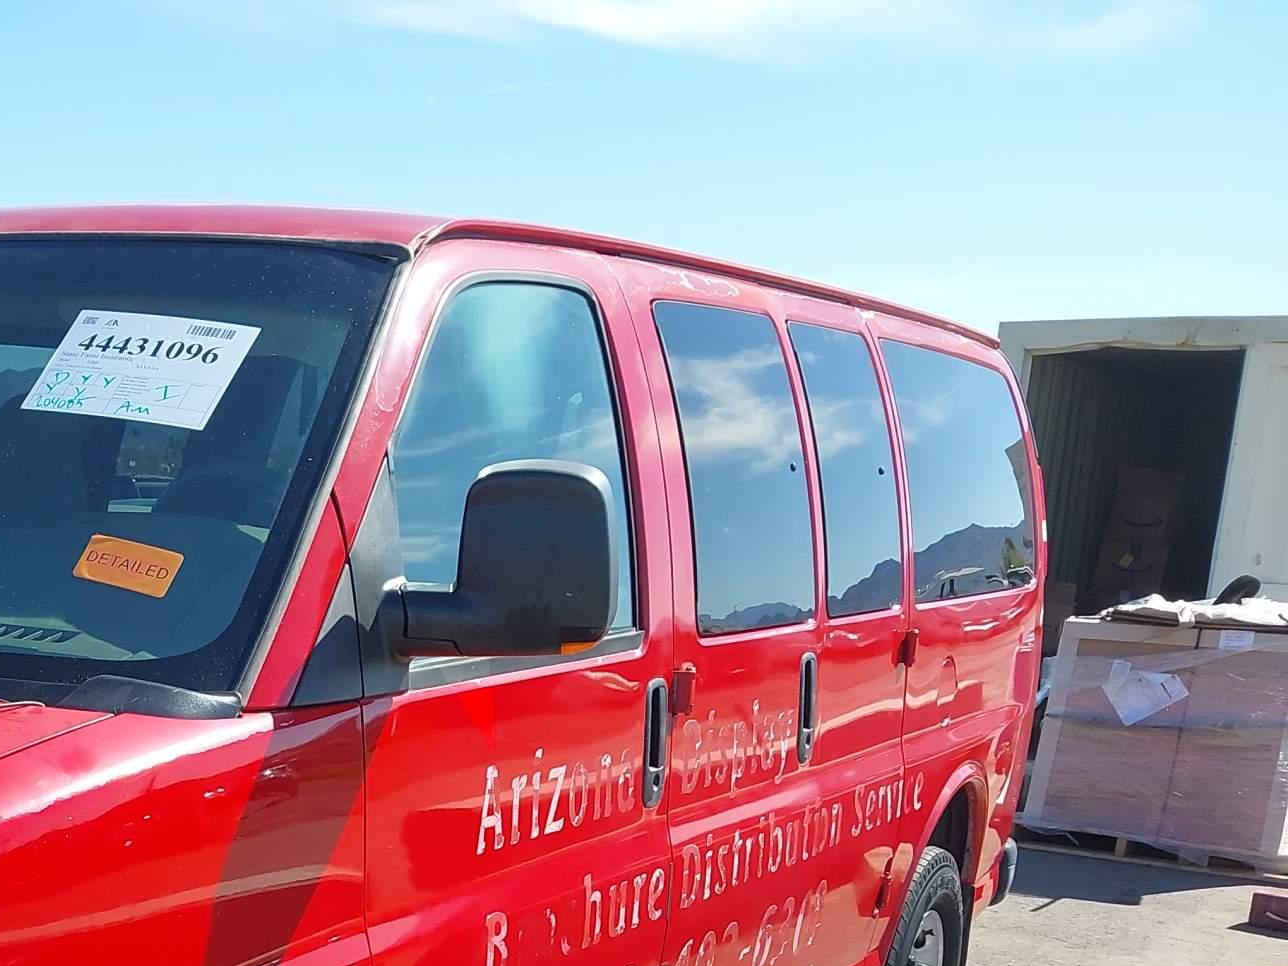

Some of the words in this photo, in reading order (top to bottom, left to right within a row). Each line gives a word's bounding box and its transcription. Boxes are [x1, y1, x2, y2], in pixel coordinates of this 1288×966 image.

[77, 333, 225, 365] 44431096
[86, 550, 169, 580] DETAILED
[476, 747, 636, 856] Arizona
